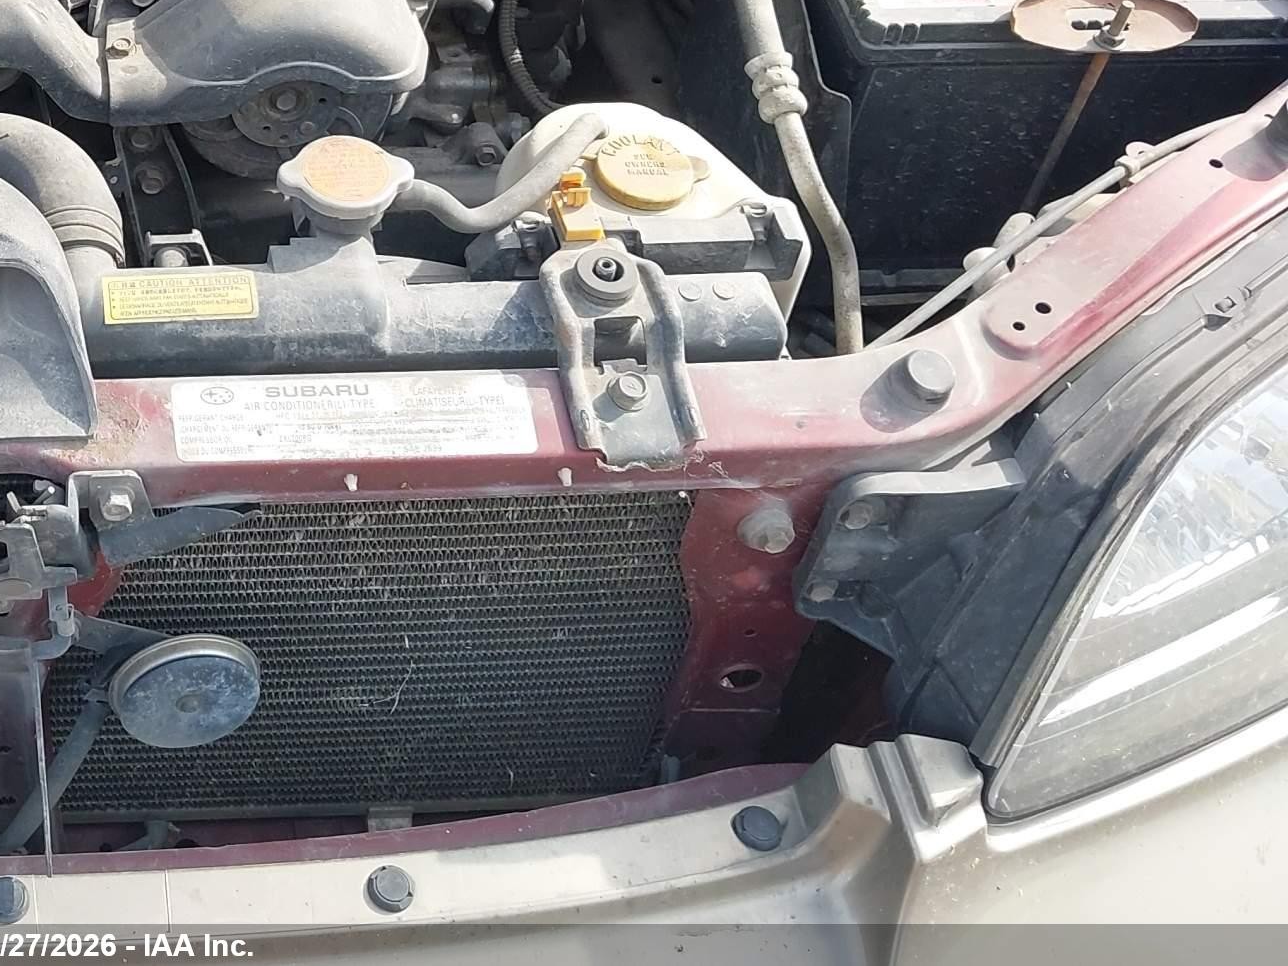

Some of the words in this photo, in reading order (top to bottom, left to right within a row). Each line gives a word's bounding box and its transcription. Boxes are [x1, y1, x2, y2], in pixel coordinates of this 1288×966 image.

[139, 279, 183, 288] CAUTION
[189, 276, 247, 286] ATTENTION
[265, 384, 369, 398] SUBARU
